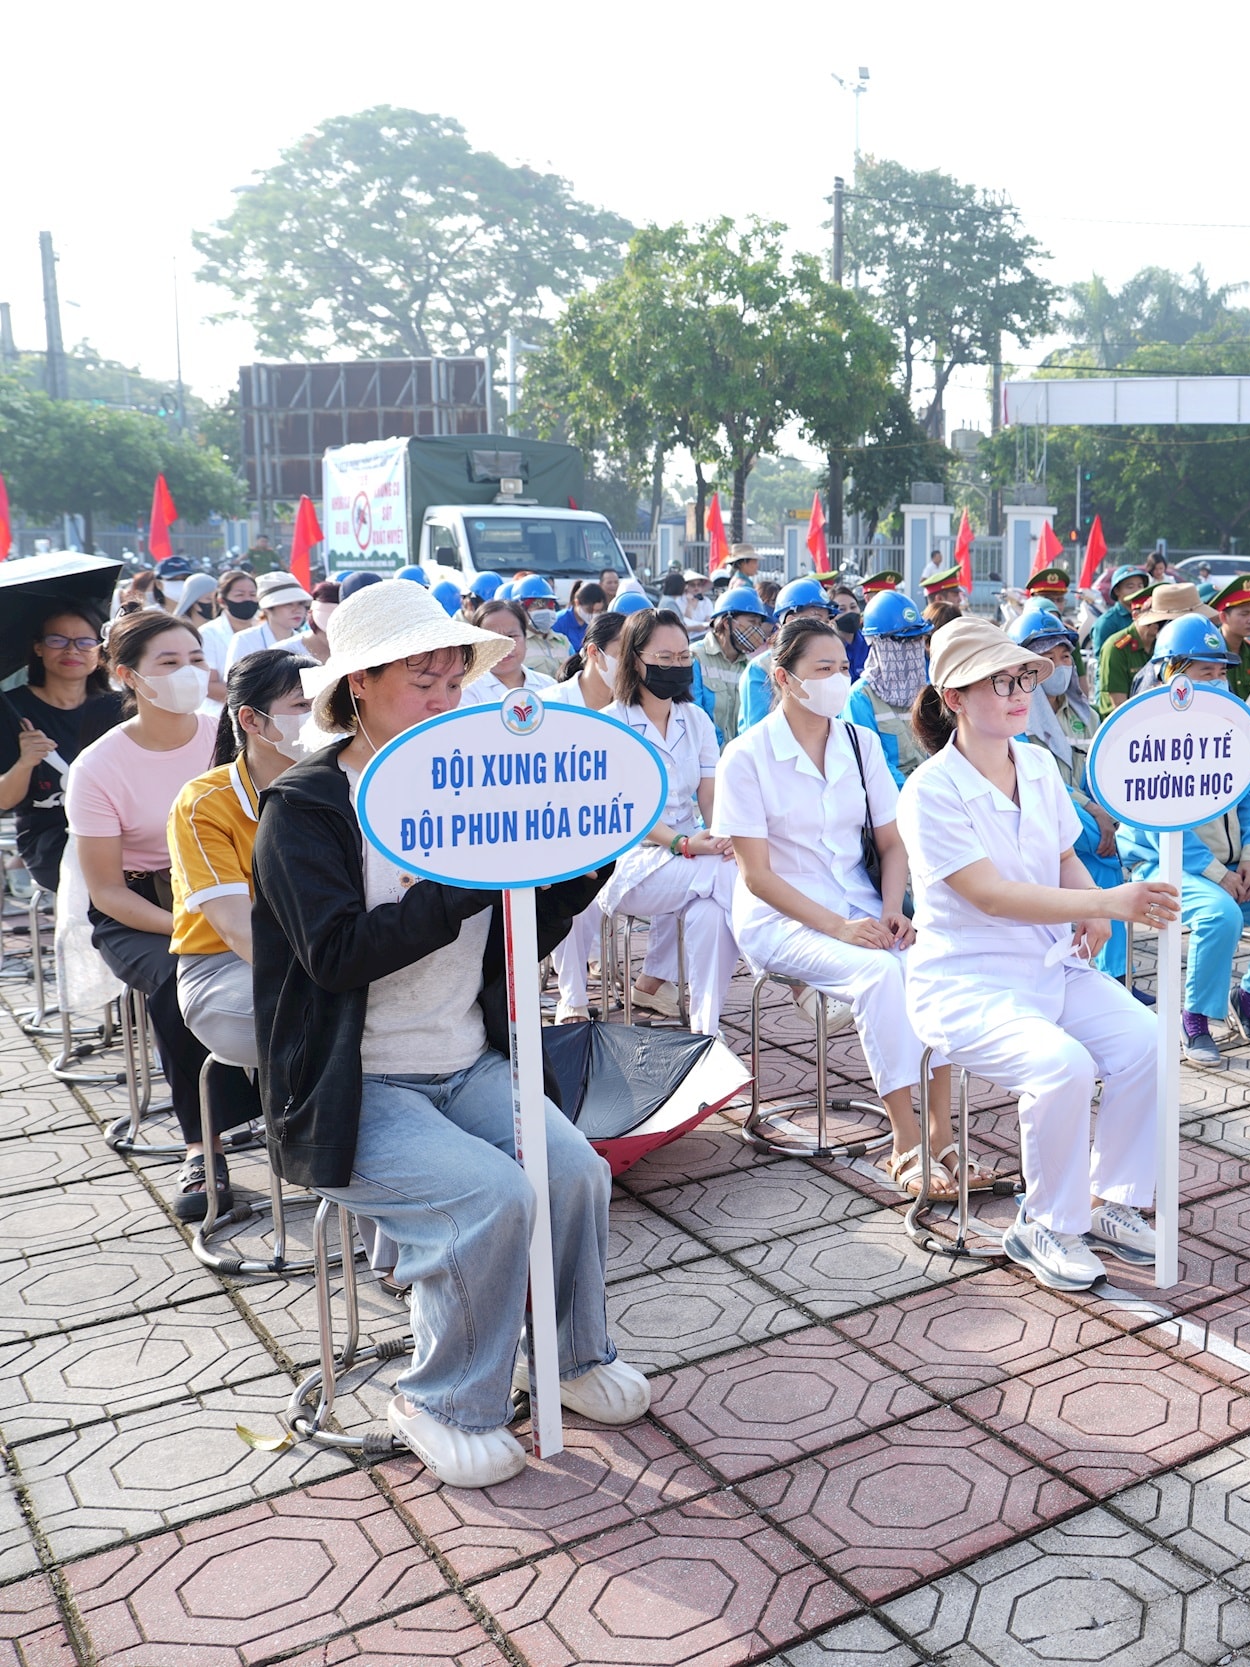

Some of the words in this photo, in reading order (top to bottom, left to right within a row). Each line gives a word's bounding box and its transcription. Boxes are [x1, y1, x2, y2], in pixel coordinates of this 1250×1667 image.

[1129, 735, 1166, 763] CÁN
[1171, 733, 1194, 765] BỘ
[1199, 737, 1209, 759] Y
[1213, 729, 1233, 759] TẾ
[431, 748, 473, 796] ĐỘI
[481, 752, 547, 787] XUNG
[554, 744, 607, 782] KÍCH
[1124, 771, 1195, 801] TRƯỜNG
[1200, 772, 1233, 800] HỌC
[400, 809, 443, 857] ĐỘI
[452, 811, 517, 846] PHUN
[526, 801, 571, 841] HÓA
[578, 792, 634, 837] CHẤT
